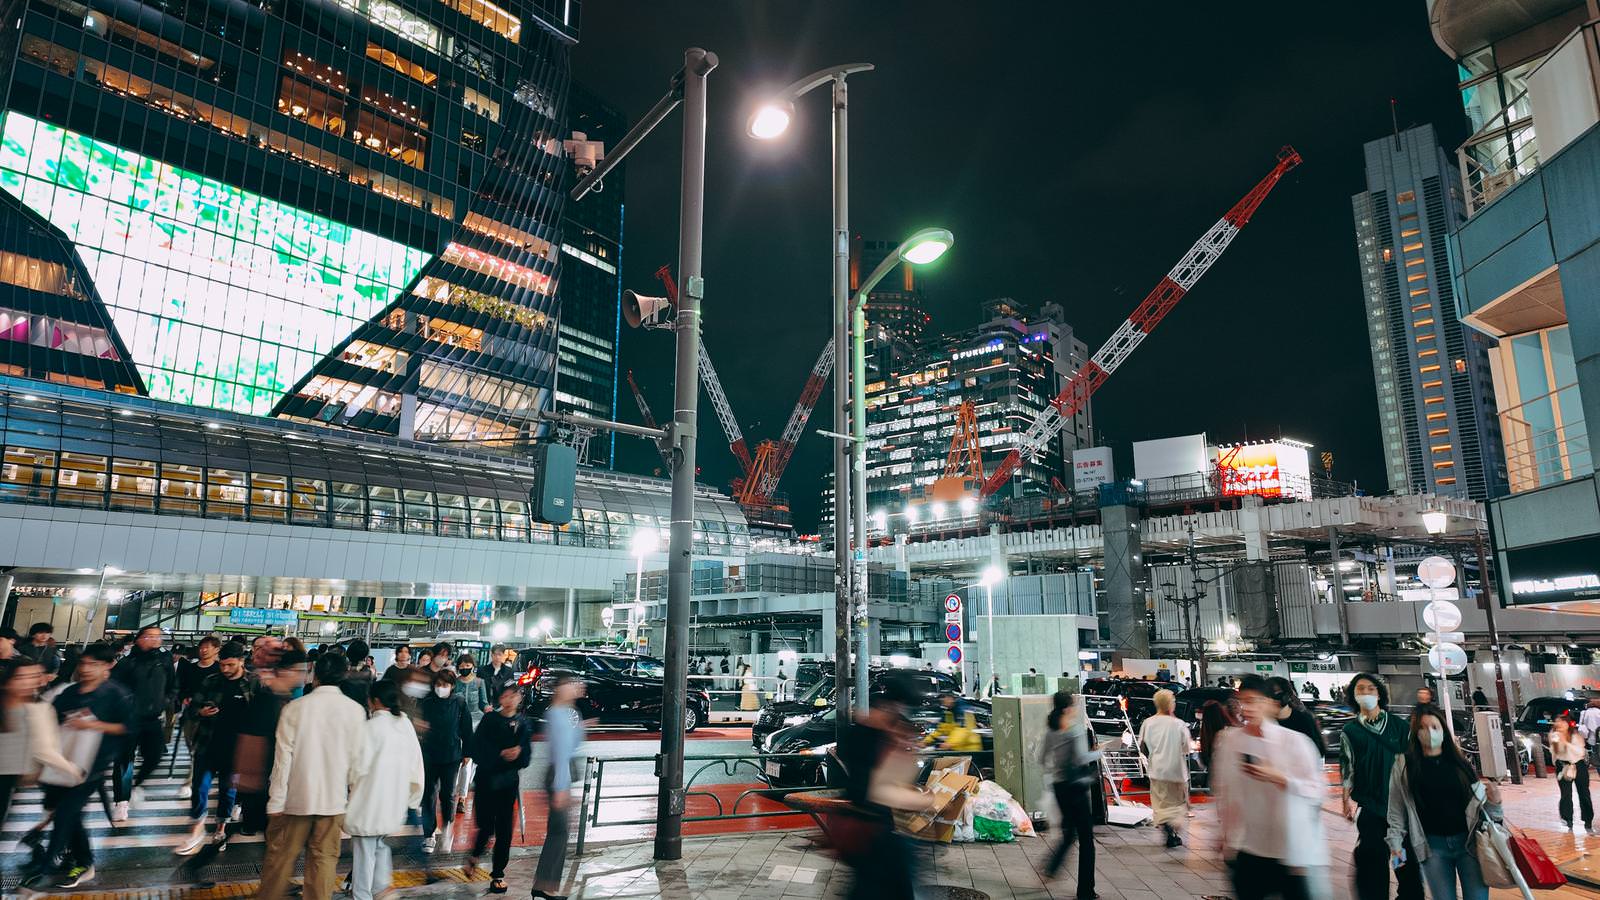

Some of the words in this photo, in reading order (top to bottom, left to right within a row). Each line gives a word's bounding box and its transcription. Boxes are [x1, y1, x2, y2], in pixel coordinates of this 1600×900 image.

[960, 343, 1004, 358] FUKURAS
[1311, 663, 1336, 671] 渋谷駅
